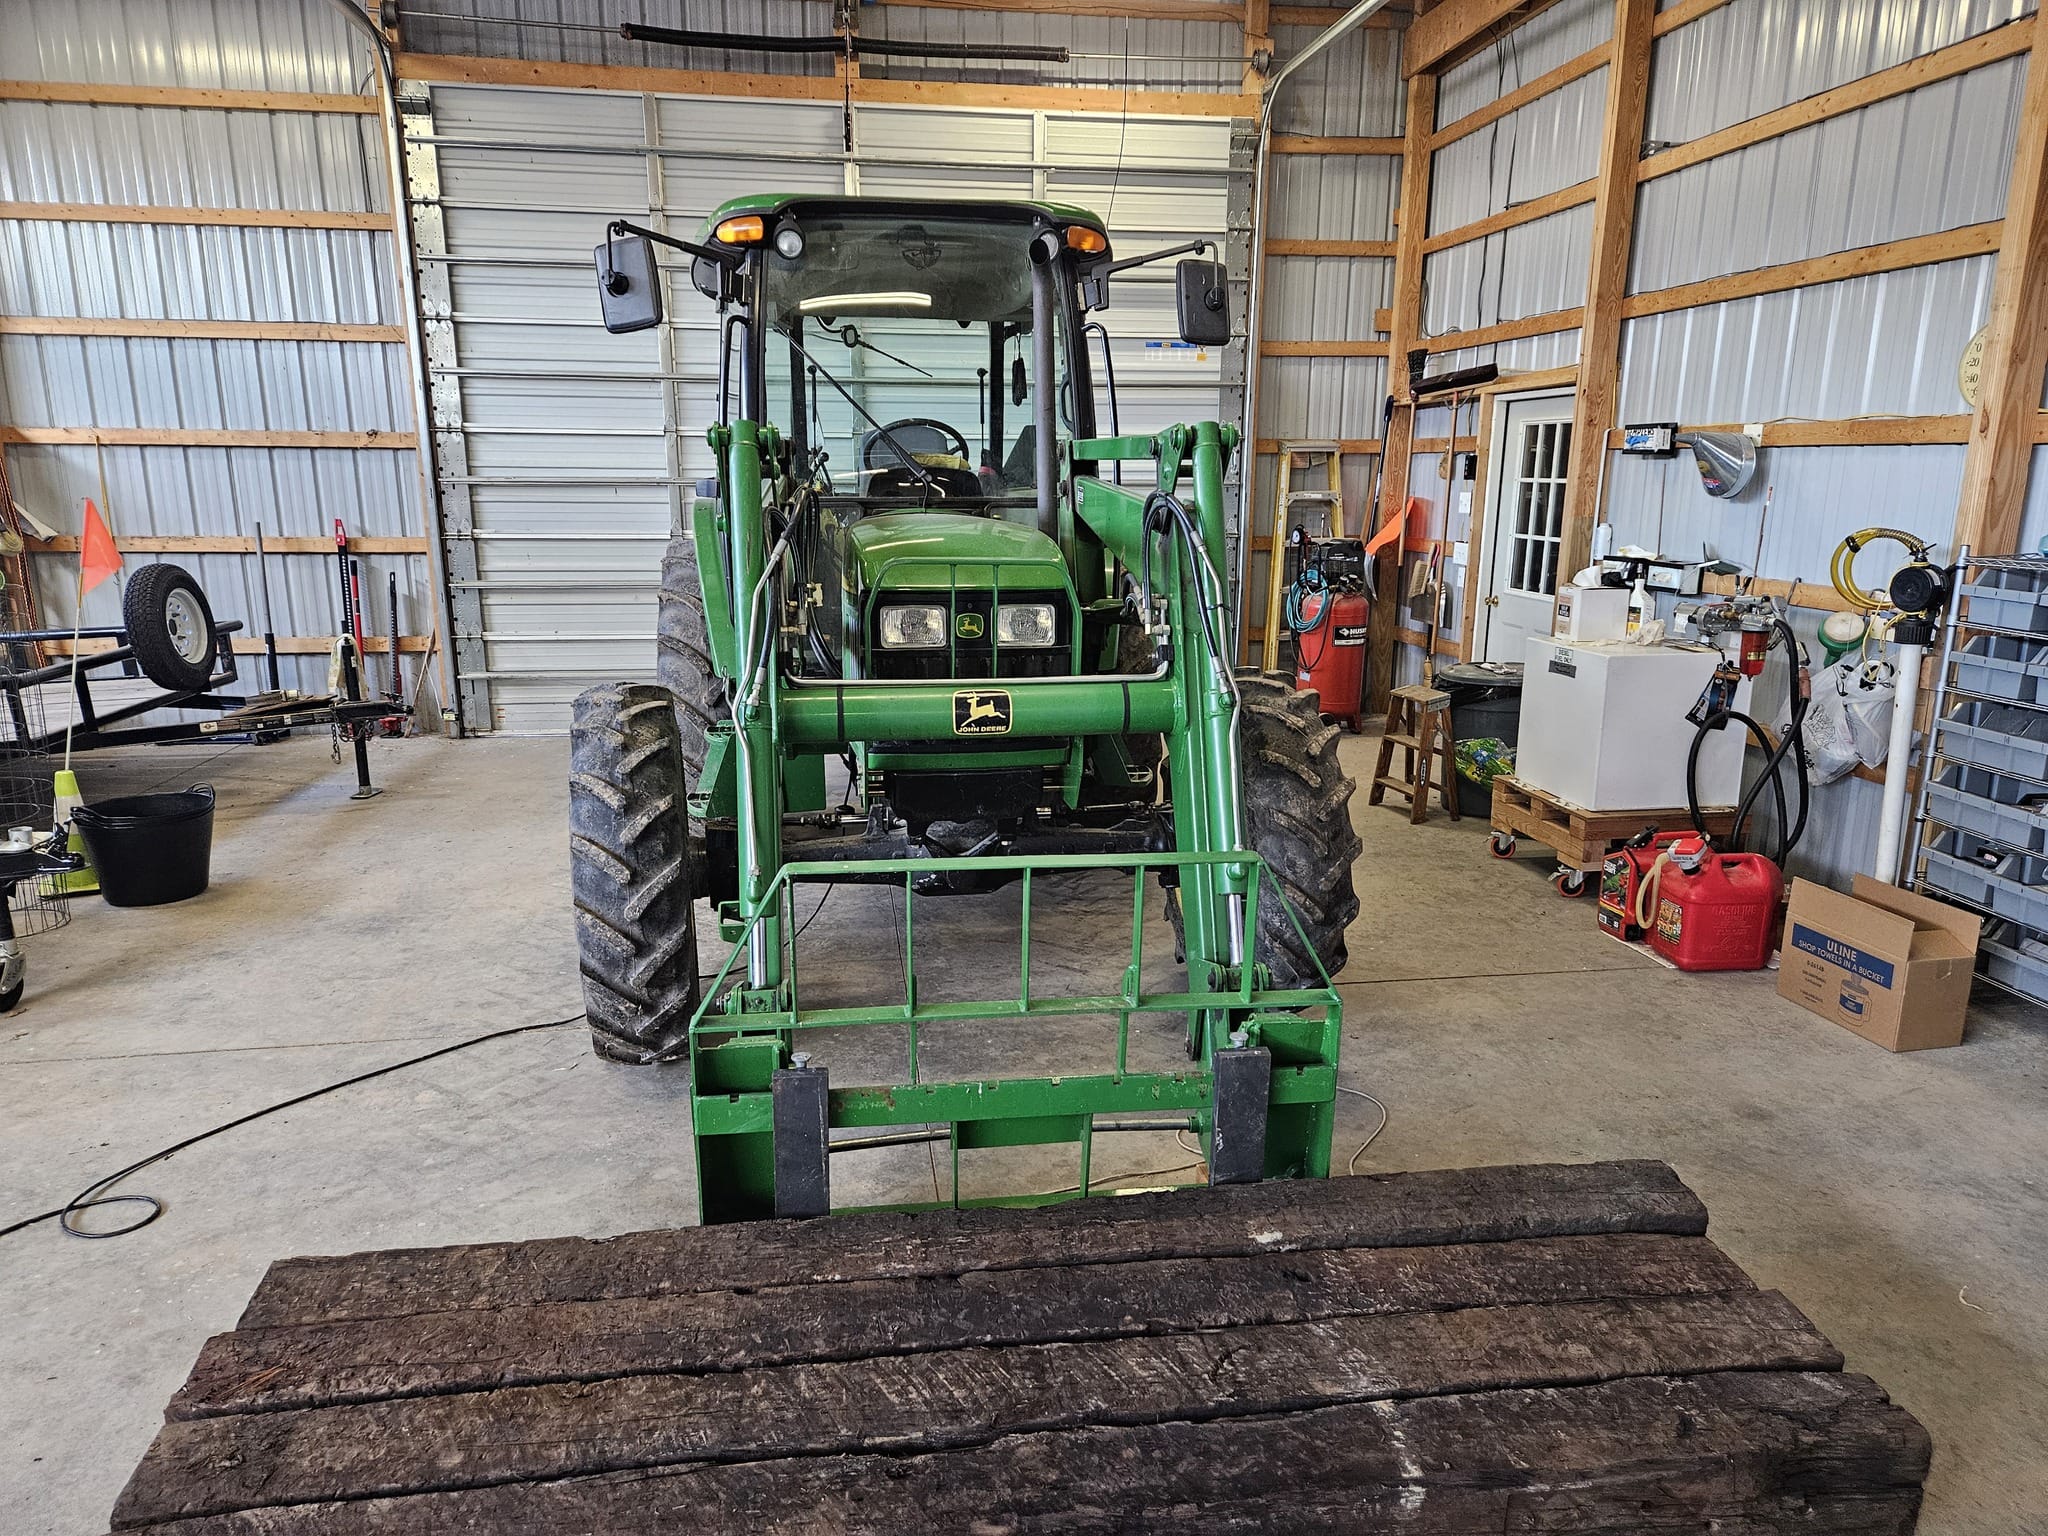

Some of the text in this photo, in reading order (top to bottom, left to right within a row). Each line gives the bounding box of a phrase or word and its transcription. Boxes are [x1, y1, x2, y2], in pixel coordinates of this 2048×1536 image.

[1350, 627, 1367, 635] HUSK
[1798, 939, 1885, 983] SHOP TOWELS IN A BUCKET
[1827, 940, 1857, 961] ULINE
